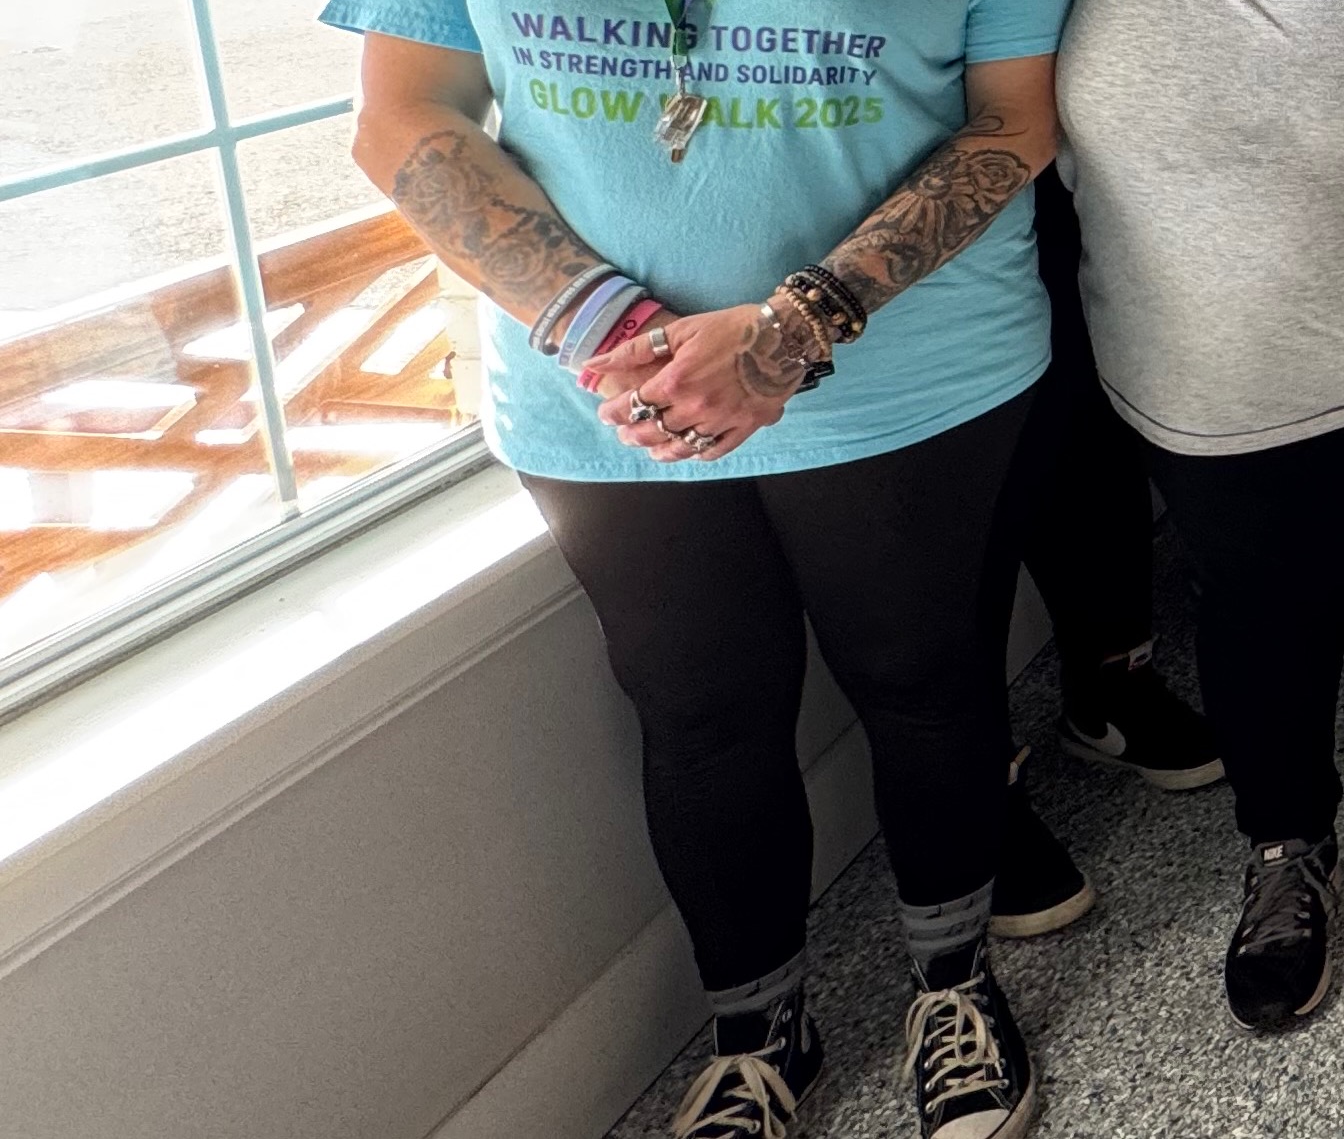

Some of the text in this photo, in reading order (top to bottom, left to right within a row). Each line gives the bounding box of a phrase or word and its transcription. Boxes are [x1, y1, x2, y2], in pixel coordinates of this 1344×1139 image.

[512, 12, 887, 59] WALKING TOGETHER
[512, 46, 877, 87] IN STRENGTH AND SOLIDARITY
[528, 78, 886, 130] GLOW ALK 2025
